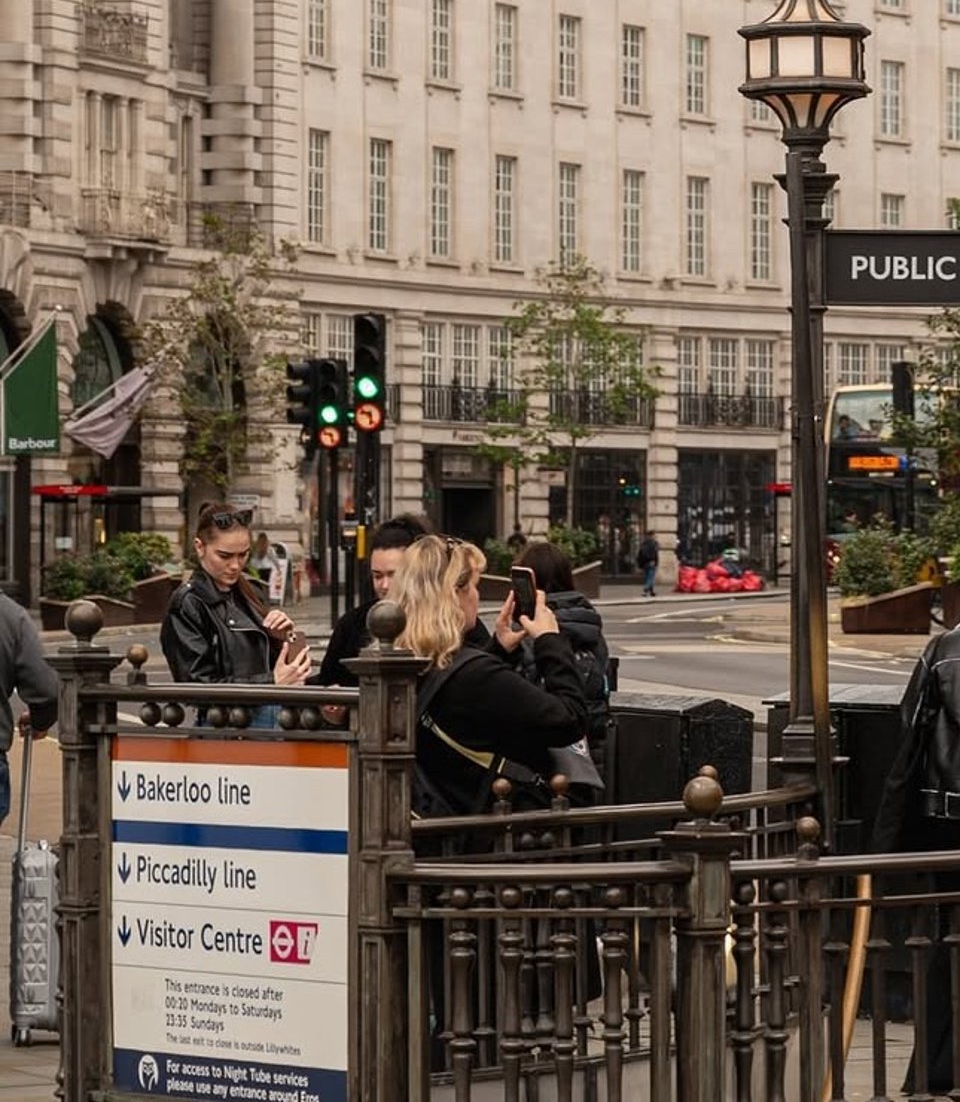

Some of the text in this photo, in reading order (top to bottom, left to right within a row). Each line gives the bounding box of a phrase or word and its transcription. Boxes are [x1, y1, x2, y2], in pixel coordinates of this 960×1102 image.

[850, 255, 957, 281] PUBLIC
[8, 438, 57, 449] Barbour
[136, 773, 251, 805] Bakerloo line
[136, 855, 256, 894] Piccadilly line
[136, 918, 194, 949] Visitor
[201, 923, 263, 955] Centre
[165, 978, 283, 1002] This entrance is closed after
[165, 996, 282, 1022] 00:20 Mondays to Saturdays
[166, 1013, 224, 1033] 23:35 Sundays
[166, 1032, 301, 1056] The last exit to close is outside Lillywhites
[166, 1059, 309, 1087] For access to Night Tube services
[166, 1078, 194, 1093] please
[196, 1083, 211, 1093] use
[213, 1084, 227, 1099] any
[229, 1086, 267, 1100] entrance
[269, 1089, 299, 1102] around
